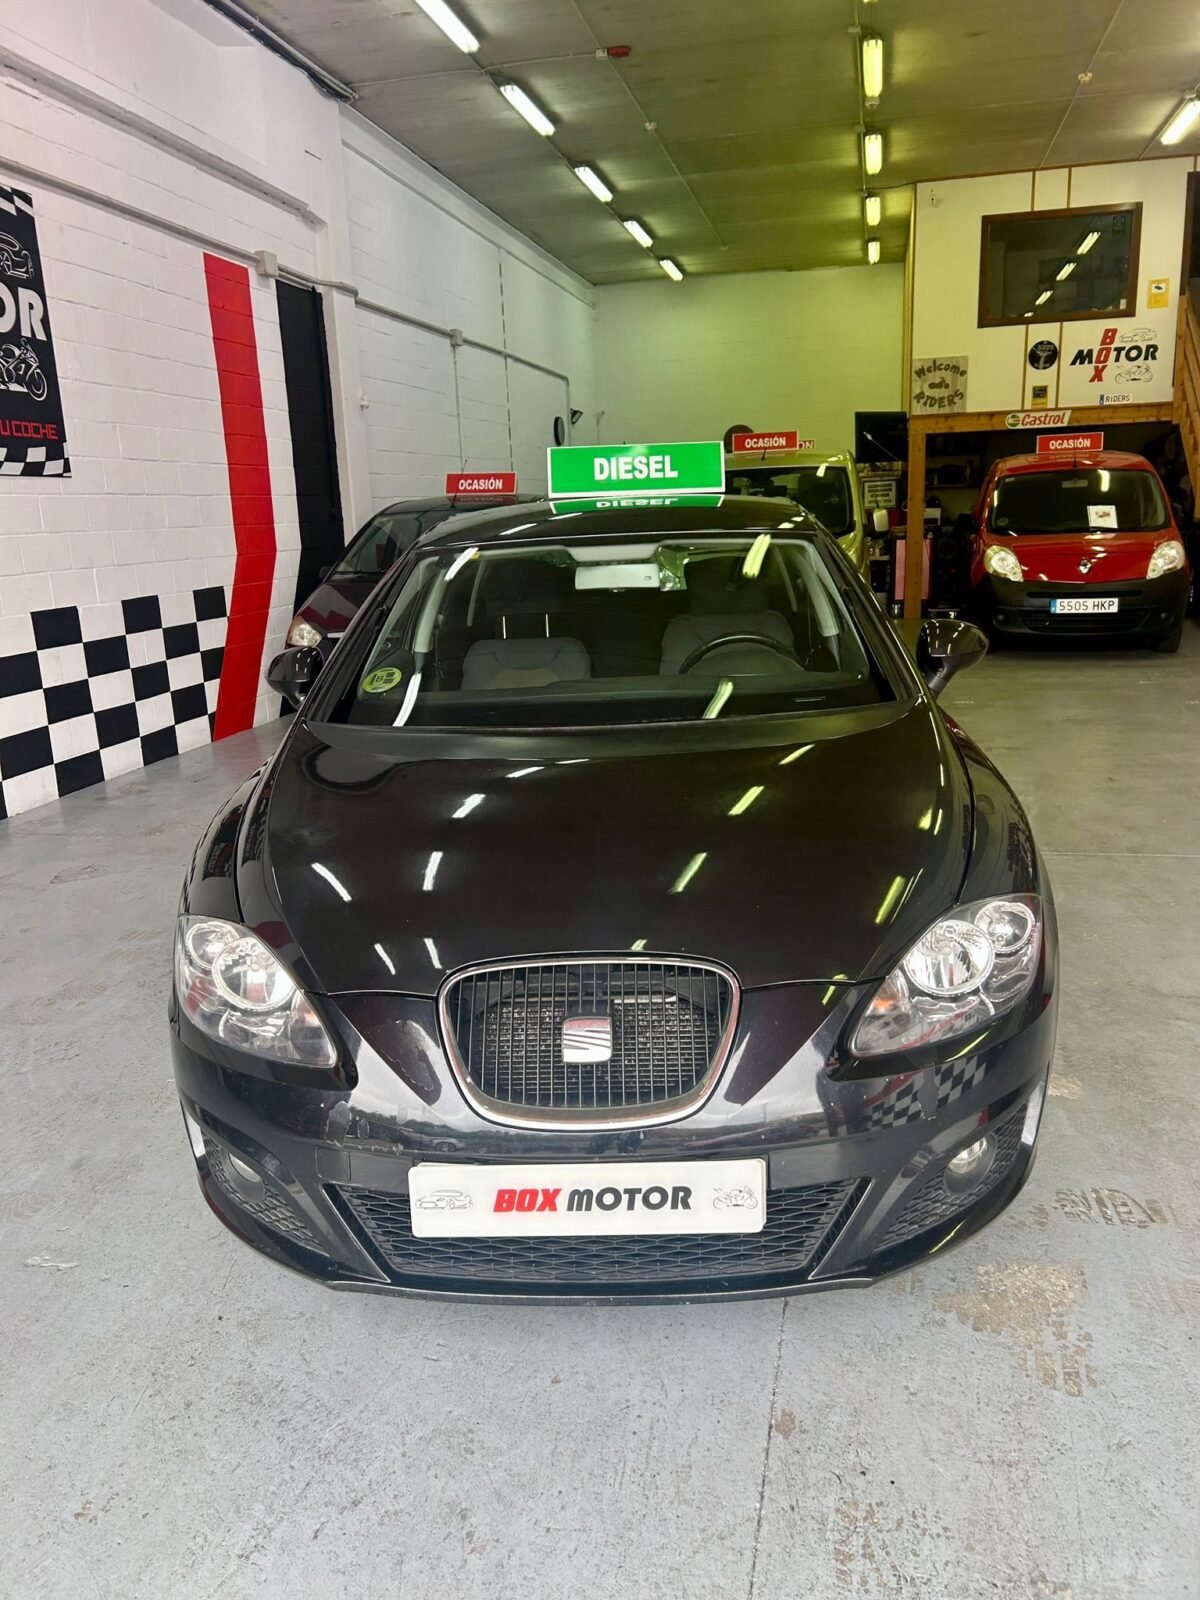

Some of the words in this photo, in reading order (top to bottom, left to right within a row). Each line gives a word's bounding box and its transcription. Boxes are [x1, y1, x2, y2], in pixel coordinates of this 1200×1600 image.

[1069, 344, 1159, 366] MOTOR
[1088, 328, 1118, 383] BOX
[914, 359, 967, 379] Welcome
[913, 389, 964, 408] RIDERS
[1105, 394, 1130, 403] RIDERS
[1021, 412, 1066, 426] Castrol
[11, 420, 58, 440] COCHE
[744, 435, 787, 449] OCASIÓN
[1049, 436, 1091, 449] OCASIÓN
[593, 455, 679, 481] DIESEL
[458, 476, 503, 490] OCASIÓN
[1059, 600, 1089, 611] 5505
[1092, 600, 1115, 611] HKP
[493, 1187, 562, 1213] BOX
[566, 1186, 692, 1213] MOTOR
